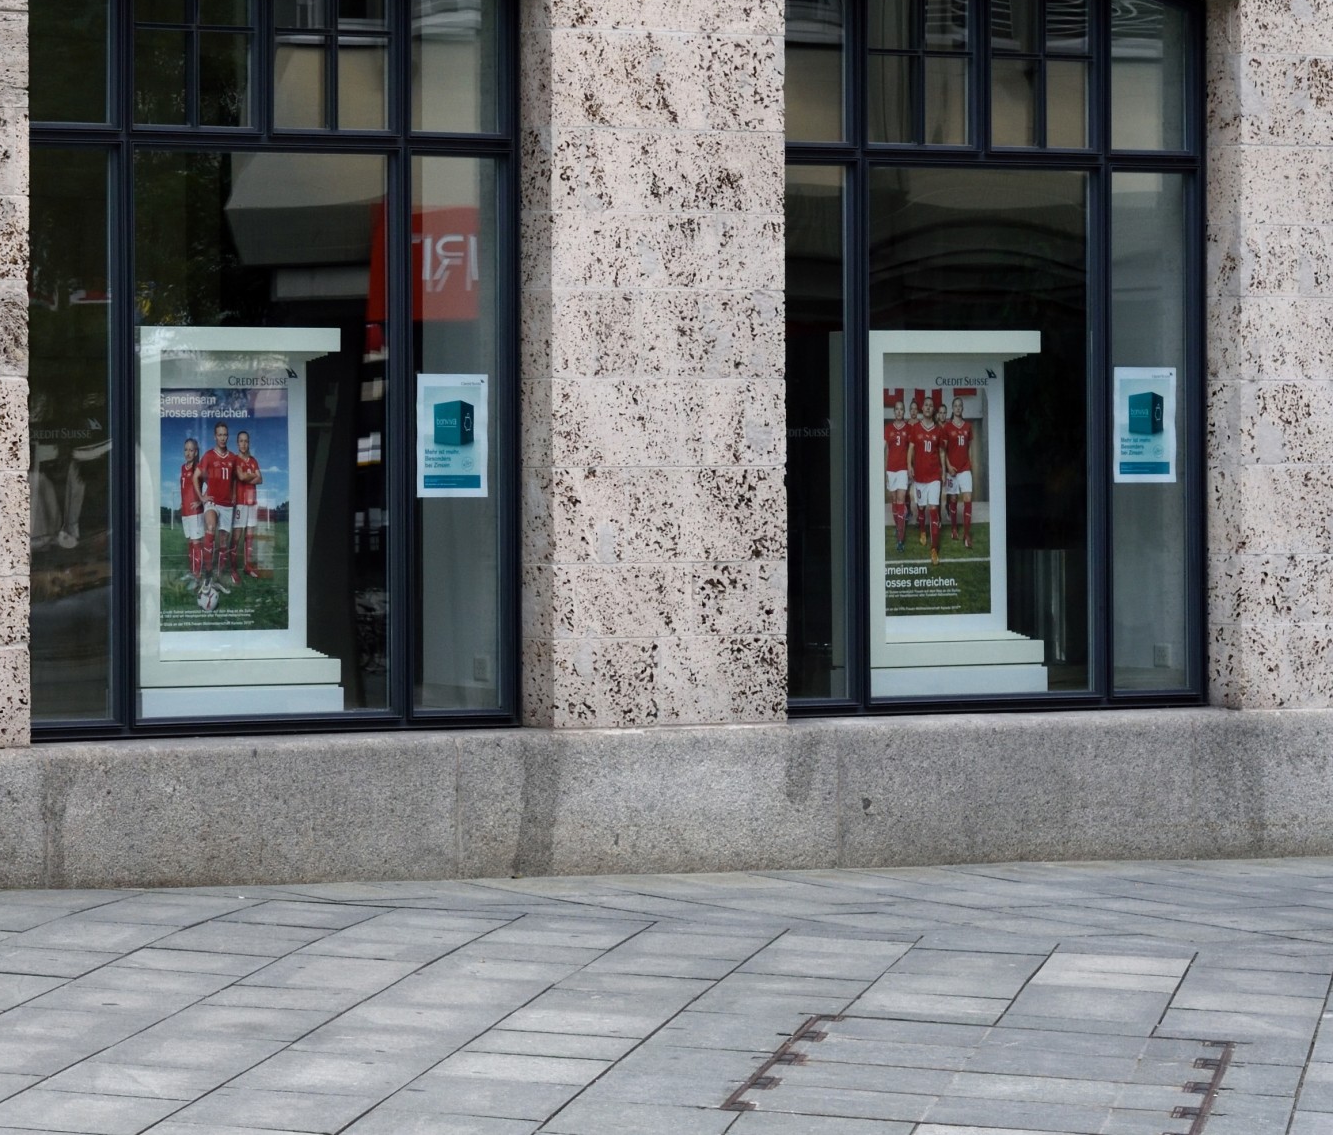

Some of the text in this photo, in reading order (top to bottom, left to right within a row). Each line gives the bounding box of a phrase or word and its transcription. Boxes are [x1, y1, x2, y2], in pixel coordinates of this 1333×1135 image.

[228, 375, 288, 387] CREDIT SUISSE
[935, 376, 989, 387] CREDIT SUISSE
[200, 406, 251, 419] erreichen.
[895, 435, 901, 446] 3
[924, 440, 932, 453] 10
[957, 435, 965, 446] 16
[221, 467, 229, 480] 11
[885, 564, 928, 575] emeinsam
[885, 576, 958, 588] osses erreichen.
